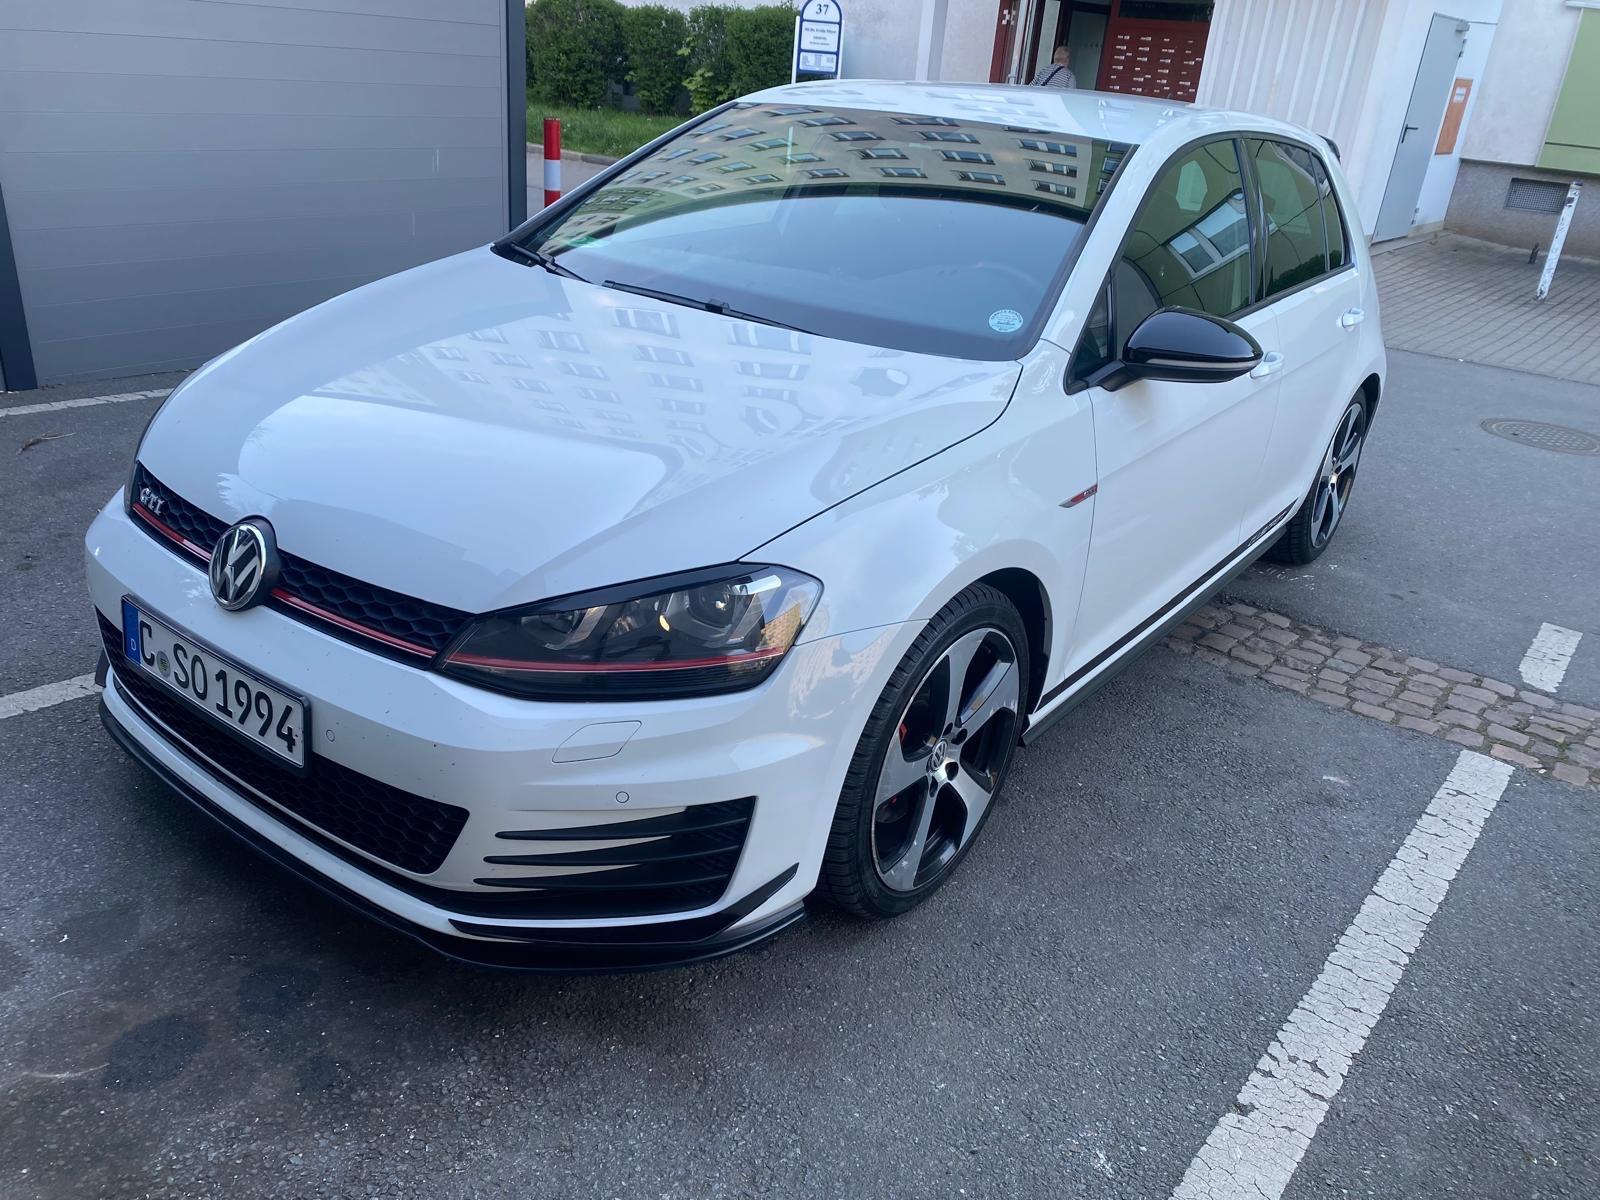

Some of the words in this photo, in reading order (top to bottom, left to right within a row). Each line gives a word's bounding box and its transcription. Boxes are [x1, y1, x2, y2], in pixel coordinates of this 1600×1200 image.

[815, 3, 829, 15] 37
[140, 487, 166, 516] GTI
[130, 638, 137, 651] D
[139, 619, 155, 667] C
